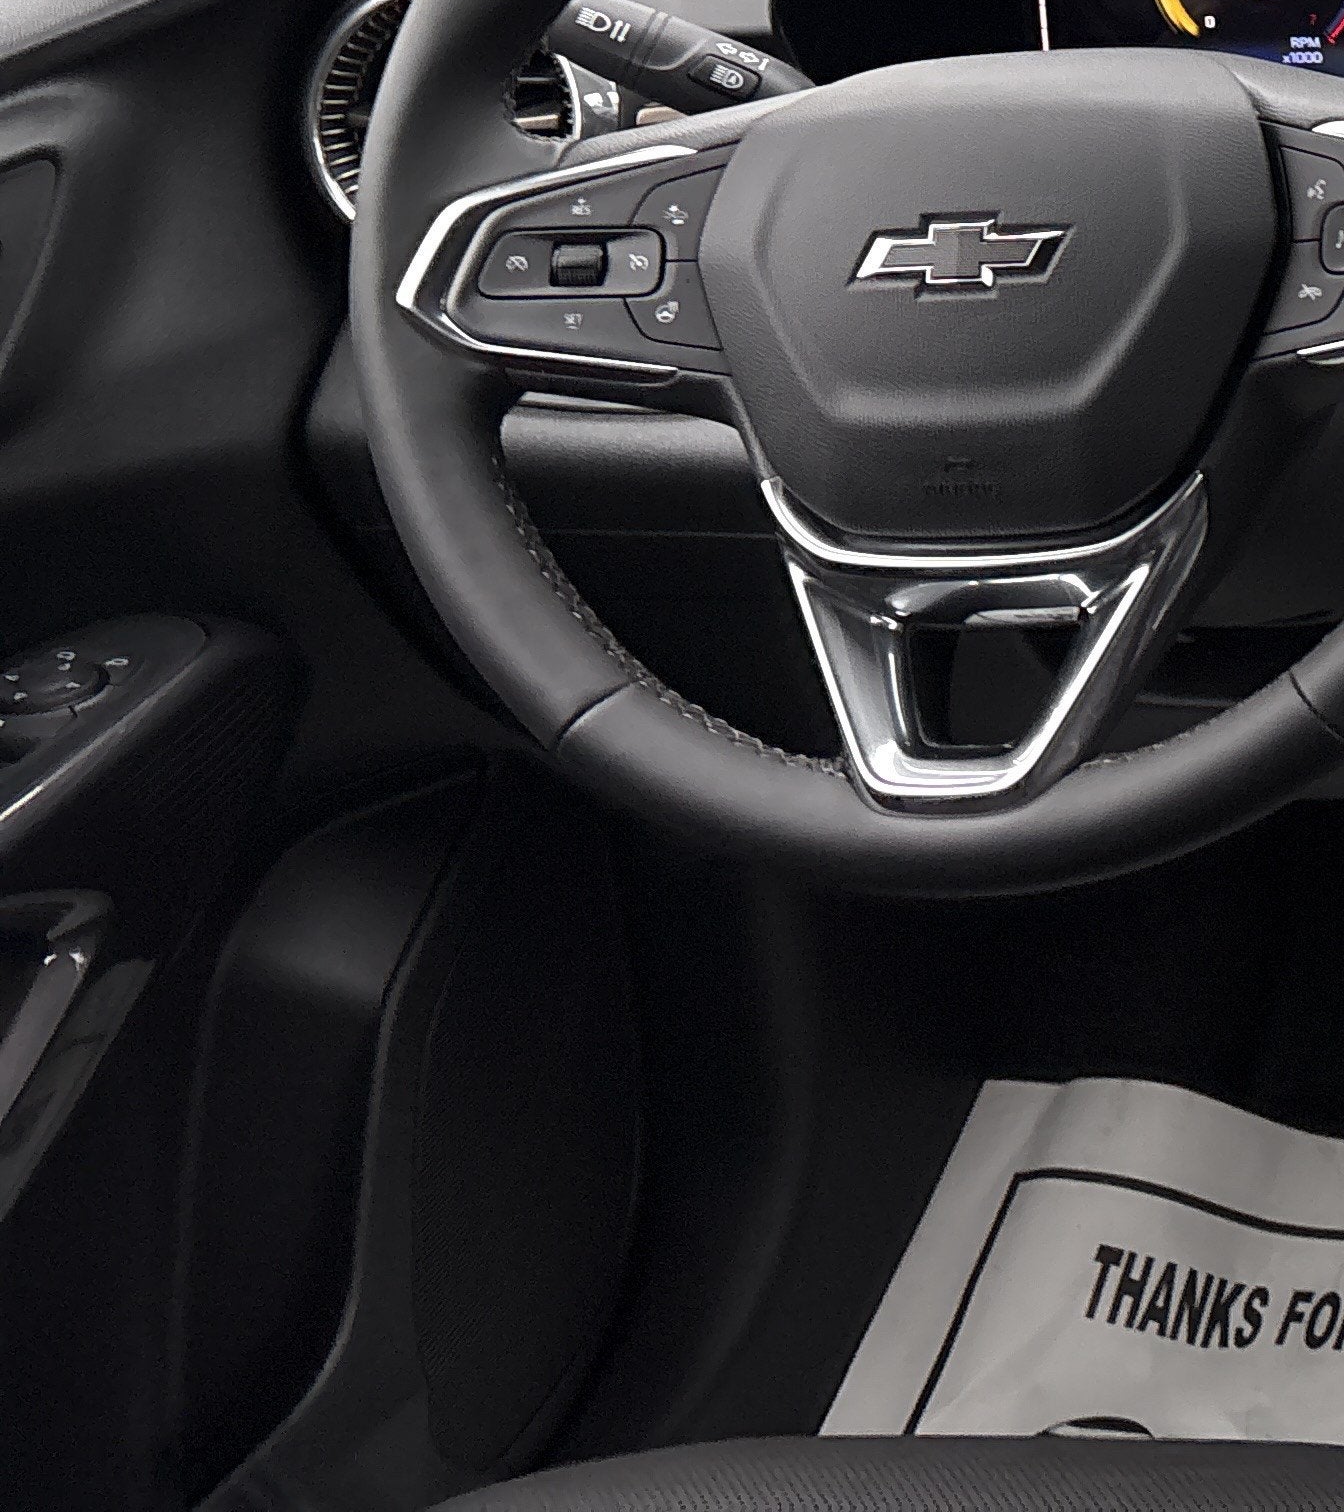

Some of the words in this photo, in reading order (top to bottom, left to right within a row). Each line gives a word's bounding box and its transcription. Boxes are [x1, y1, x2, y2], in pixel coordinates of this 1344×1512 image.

[1290, 37, 1321, 48] RPM
[1282, 51, 1323, 64] x1000
[1085, 1244, 1269, 1350] THANKS
